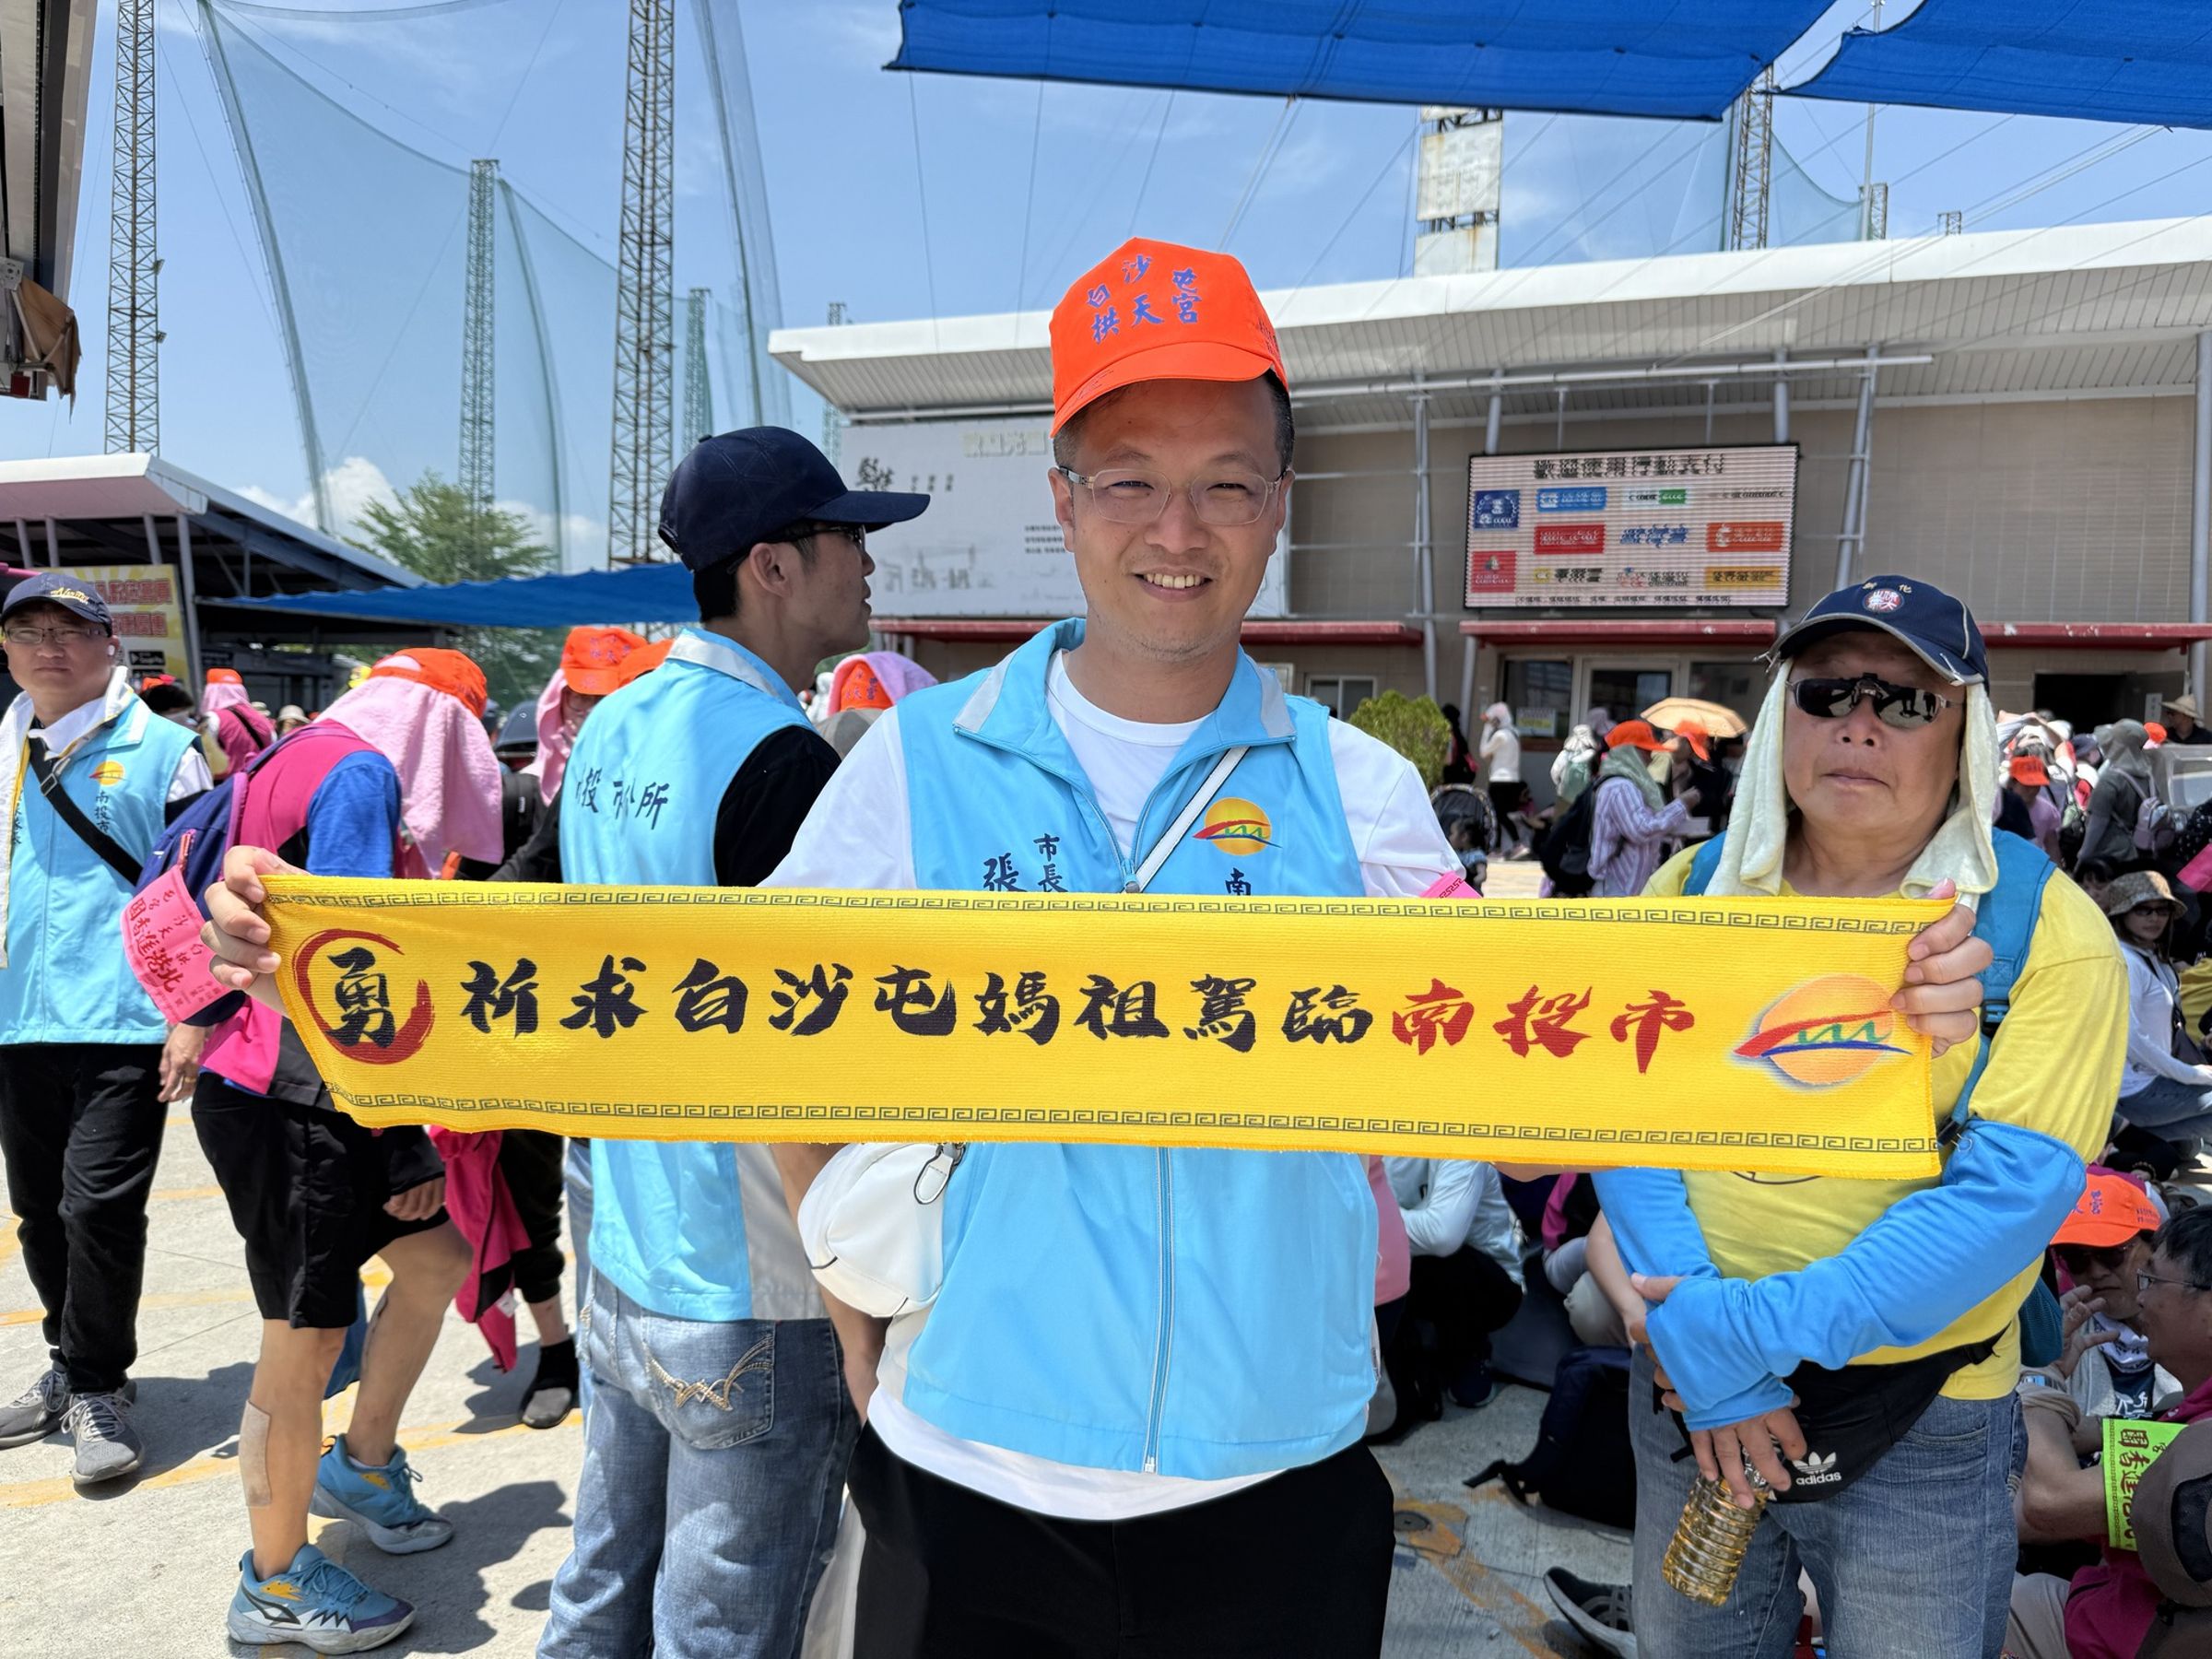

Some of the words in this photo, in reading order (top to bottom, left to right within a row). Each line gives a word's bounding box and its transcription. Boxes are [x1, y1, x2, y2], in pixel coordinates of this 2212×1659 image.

[1086, 253, 1199, 309] 白沙屯
[1091, 292, 1203, 345] 拱天宮
[982, 852, 1028, 892] 張
[1033, 832, 1069, 892] 市長
[1225, 867, 1252, 896] 南
[327, 946, 397, 1049] 勇
[461, 955, 1695, 1073] 祈求白沙屯媽祖駕臨南投市
[1795, 1472, 1842, 1486] adidas
